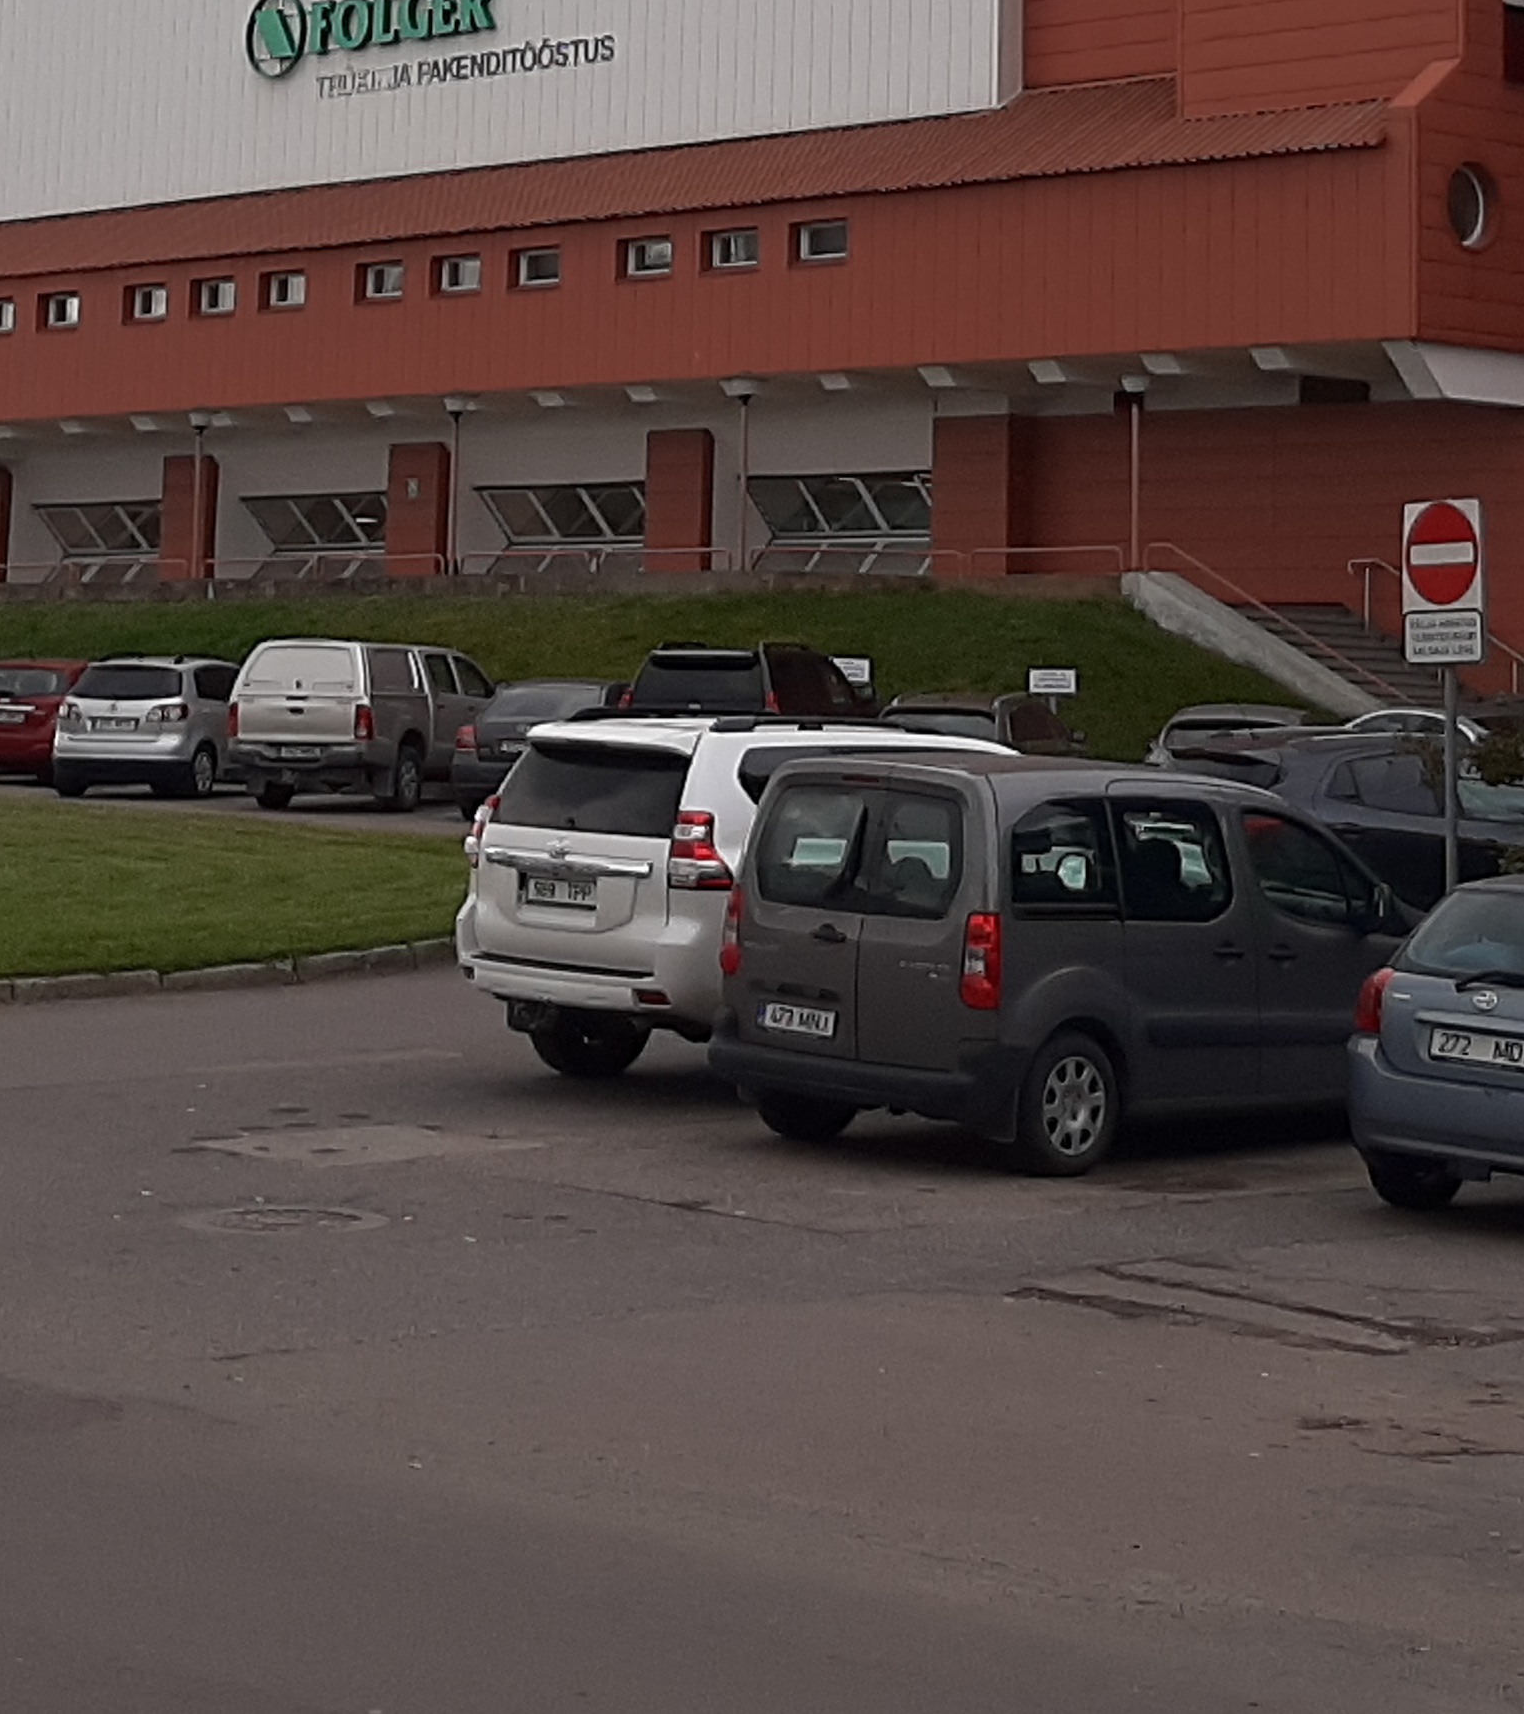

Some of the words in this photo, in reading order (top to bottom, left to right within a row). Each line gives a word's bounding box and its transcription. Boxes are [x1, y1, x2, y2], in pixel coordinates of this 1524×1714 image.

[388, 62, 412, 90] JA
[417, 35, 616, 86] PAKENDITÖÖSTUS
[1438, 1032, 1472, 1056] 272
